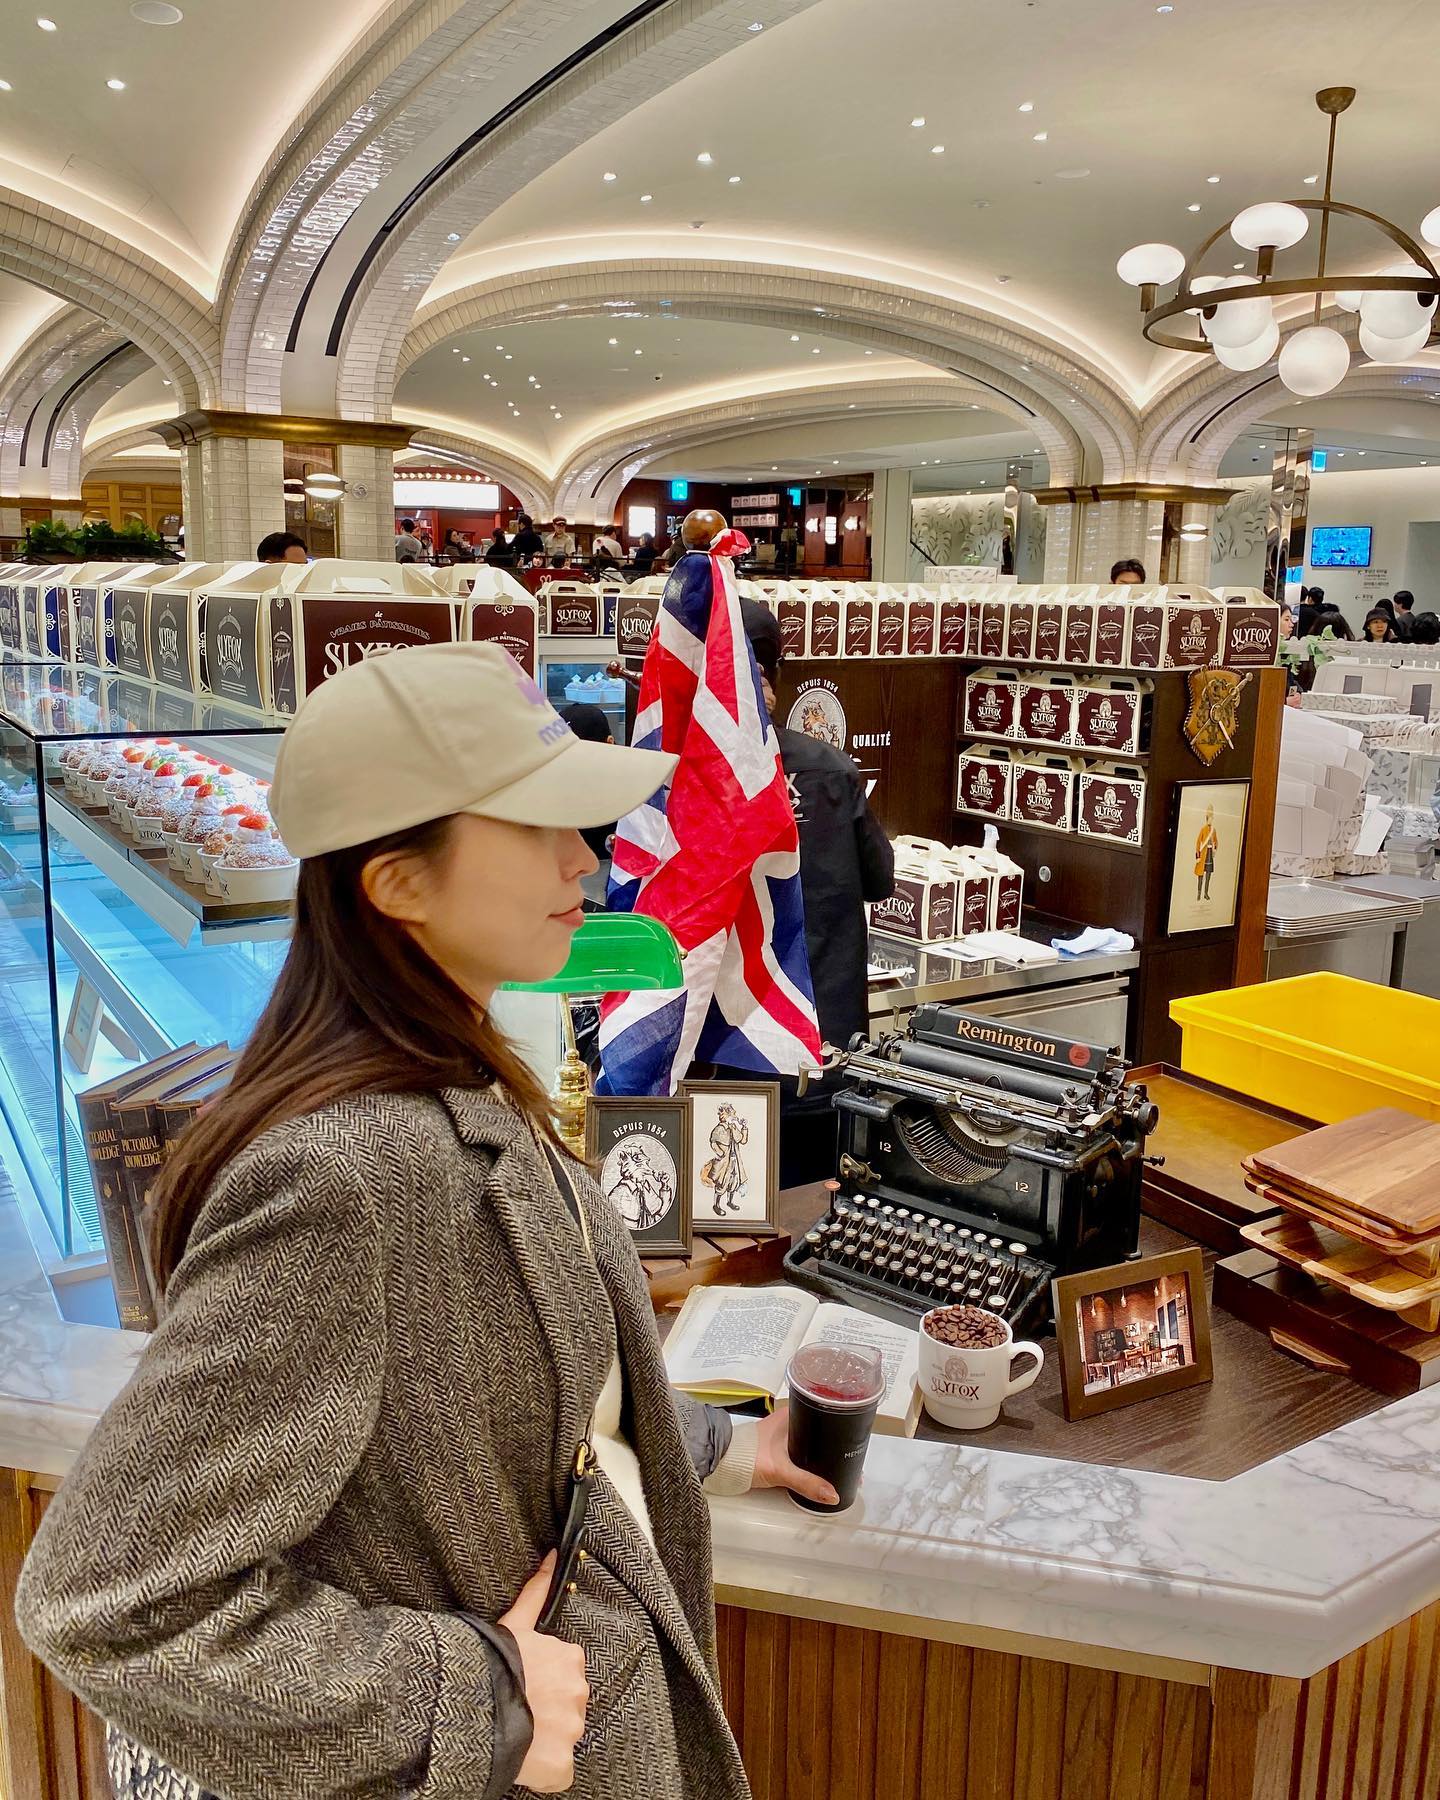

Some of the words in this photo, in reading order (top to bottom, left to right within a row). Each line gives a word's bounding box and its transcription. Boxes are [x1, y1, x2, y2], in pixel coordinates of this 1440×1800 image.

[557, 609, 592, 623] SLYFOX
[620, 618, 653, 638] SLYFOX
[1180, 636, 1208, 650] SLYFOX
[1231, 628, 1272, 648] SLYFOX
[216, 633, 244, 672] SLYFOX
[796, 678, 821, 694] DEPUIS
[823, 679, 839, 694] 1854
[977, 706, 1002, 720] SLYFOX
[1030, 712, 1057, 727] SLYFOX
[1089, 718, 1118, 733] SLYFOX
[852, 731, 891, 749] QUALITÉ
[969, 784, 994, 799] SLYFOX
[1026, 794, 1053, 810] SLYFOX
[1094, 805, 1123, 822] SLYFOX
[957, 1019, 1056, 1057] Remington
[612, 1121, 643, 1138] DEPUIS
[647, 1122, 667, 1138] 1854
[121, 1135, 160, 1153] PICTORIAL
[879, 1141, 892, 1153] 12
[124, 1152, 161, 1169] KNOWLEDGE
[1015, 1181, 1029, 1193] 12
[930, 1376, 980, 1401] SLYFOX
